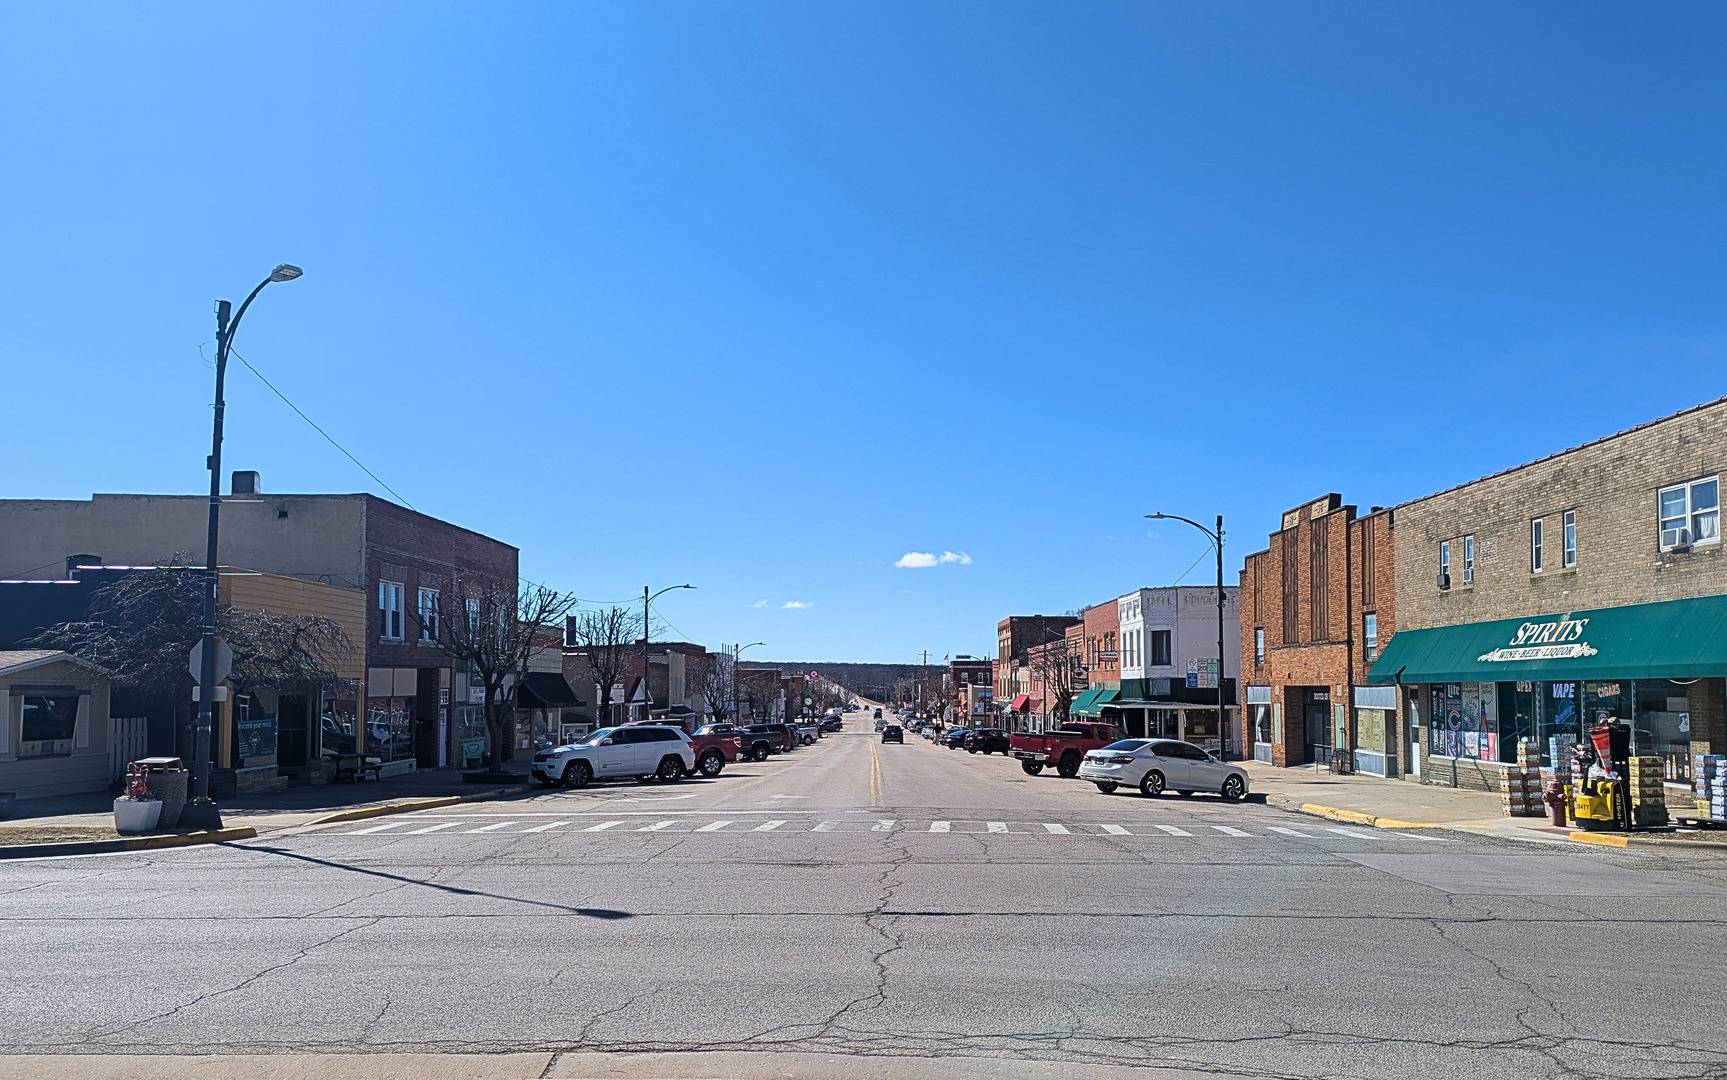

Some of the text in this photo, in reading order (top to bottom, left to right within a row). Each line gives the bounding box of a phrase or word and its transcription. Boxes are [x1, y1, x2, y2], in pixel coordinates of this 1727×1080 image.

[1509, 618, 1590, 646] SPIRITS
[1499, 646, 1575, 660] WINE BEER LIQUOR
[1447, 684, 1461, 698] Lite
[1516, 680, 1532, 693] OPEN
[1552, 683, 1576, 698] VAPE
[1597, 683, 1621, 698] CIGARS
[253, 722, 261, 730] your
